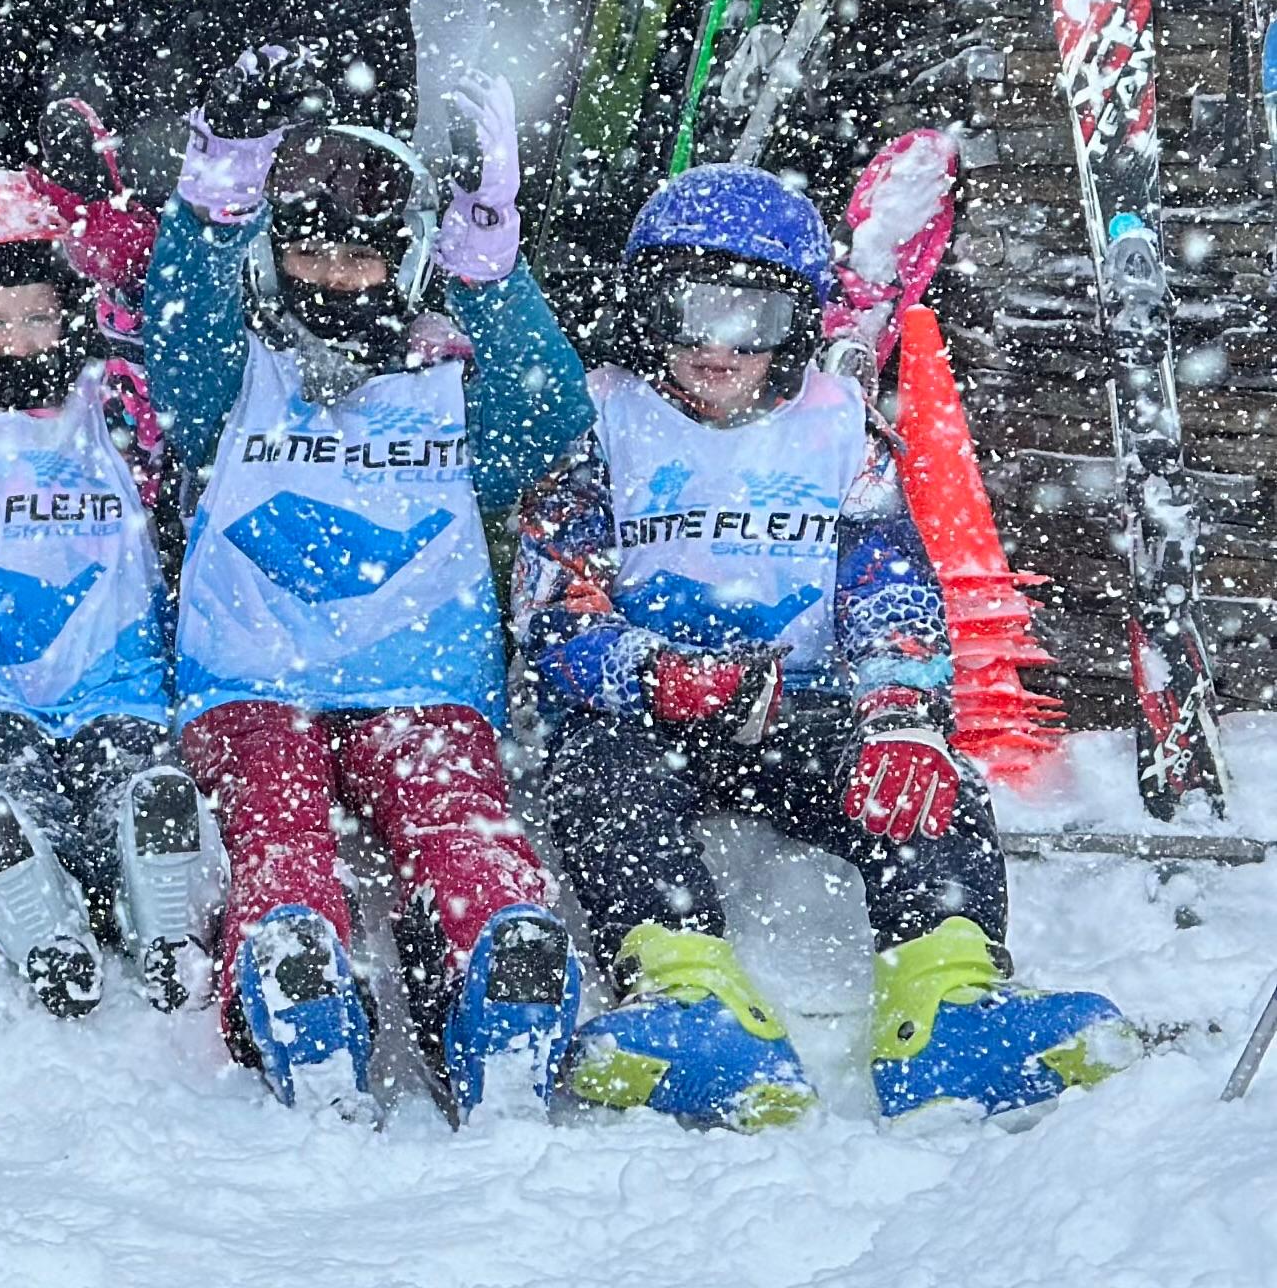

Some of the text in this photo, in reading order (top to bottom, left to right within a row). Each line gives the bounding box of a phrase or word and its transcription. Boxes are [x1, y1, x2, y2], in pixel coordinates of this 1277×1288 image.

[241, 433, 341, 463] DIME
[4, 493, 123, 524] FLEJTA
[619, 510, 838, 548] DIME FLEJT
[709, 541, 762, 556] SKI
